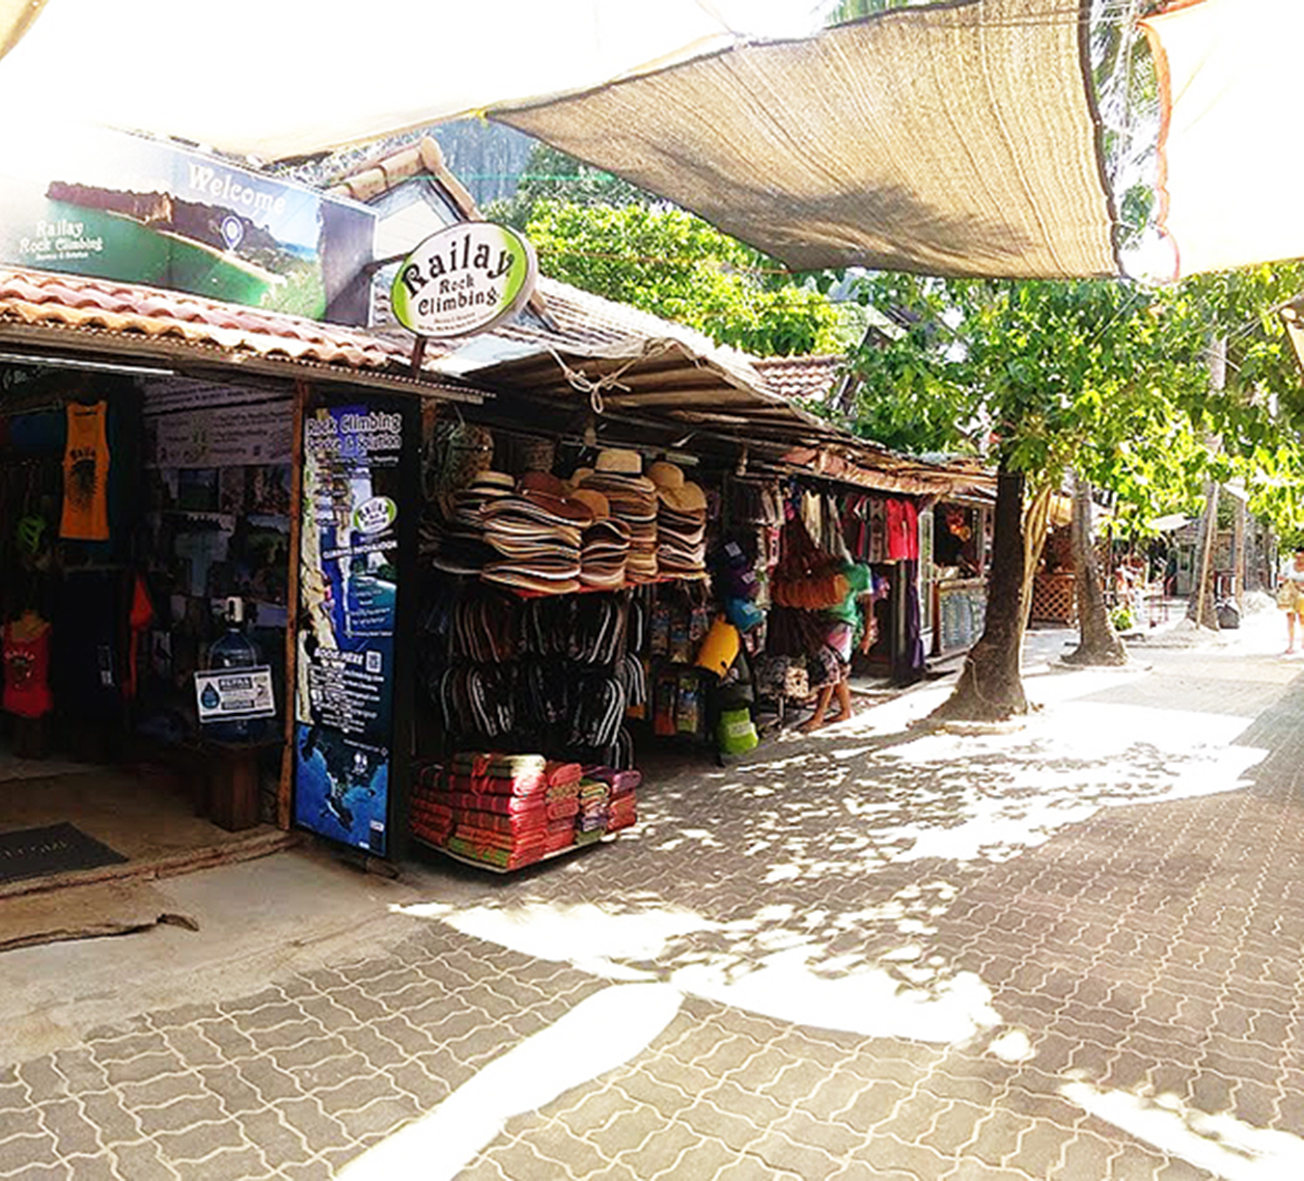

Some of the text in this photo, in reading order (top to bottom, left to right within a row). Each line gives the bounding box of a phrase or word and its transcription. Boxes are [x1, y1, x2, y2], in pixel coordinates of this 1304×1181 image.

[187, 161, 289, 216] Welcome
[36, 218, 84, 238] Railay
[19, 236, 104, 253] Rock Climbing
[401, 232, 517, 300] Railay
[439, 272, 477, 297] Rock
[417, 286, 502, 318] Climbing
[304, 417, 338, 437] Rock
[339, 411, 403, 434] Climbing
